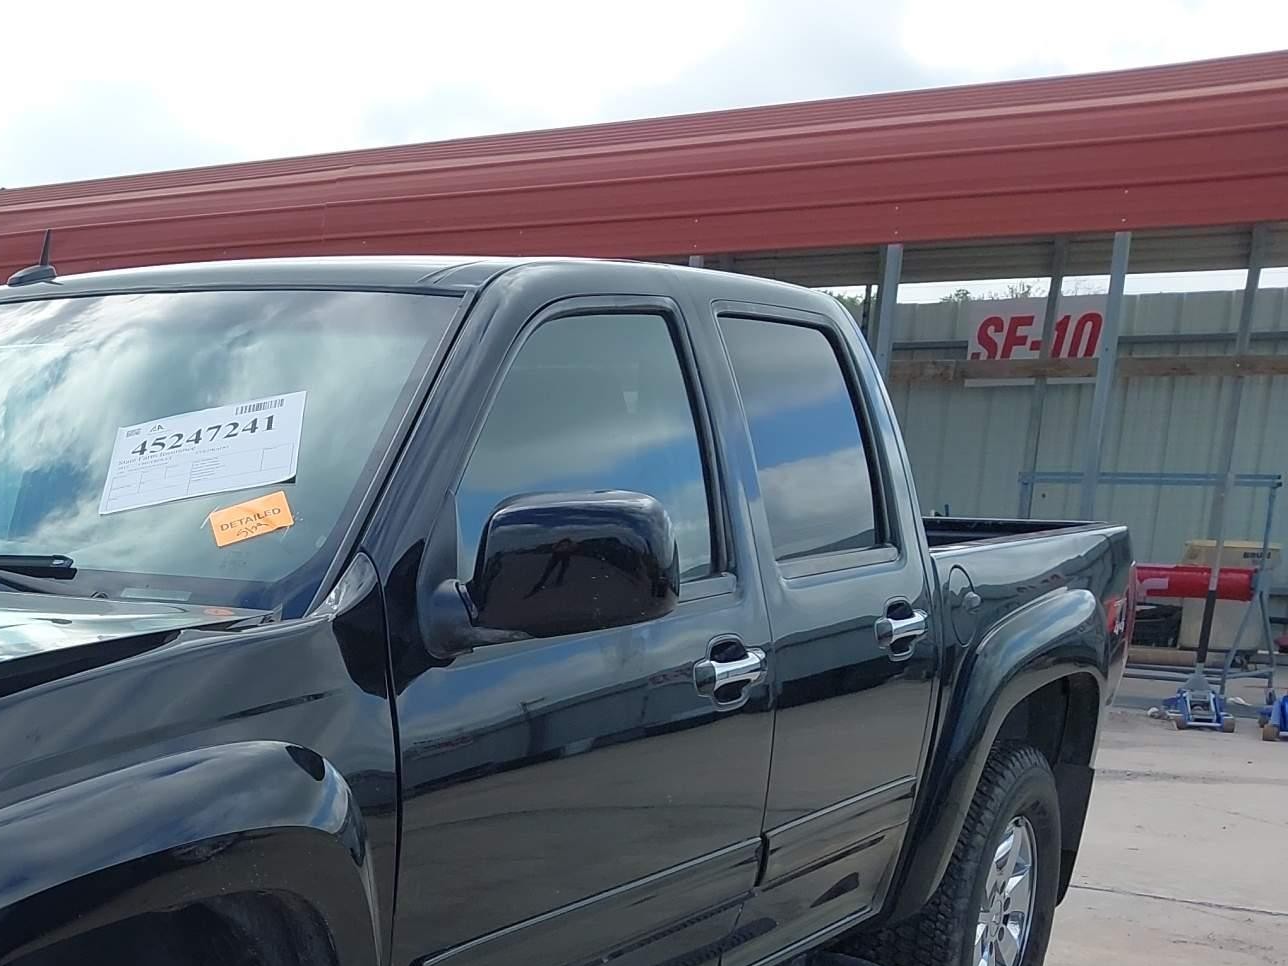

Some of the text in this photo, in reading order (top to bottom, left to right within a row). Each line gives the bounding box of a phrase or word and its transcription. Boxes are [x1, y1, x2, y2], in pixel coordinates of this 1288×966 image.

[970, 312, 1104, 361] SF-10
[131, 415, 275, 456] 45247241
[220, 507, 281, 532] DETAILED
